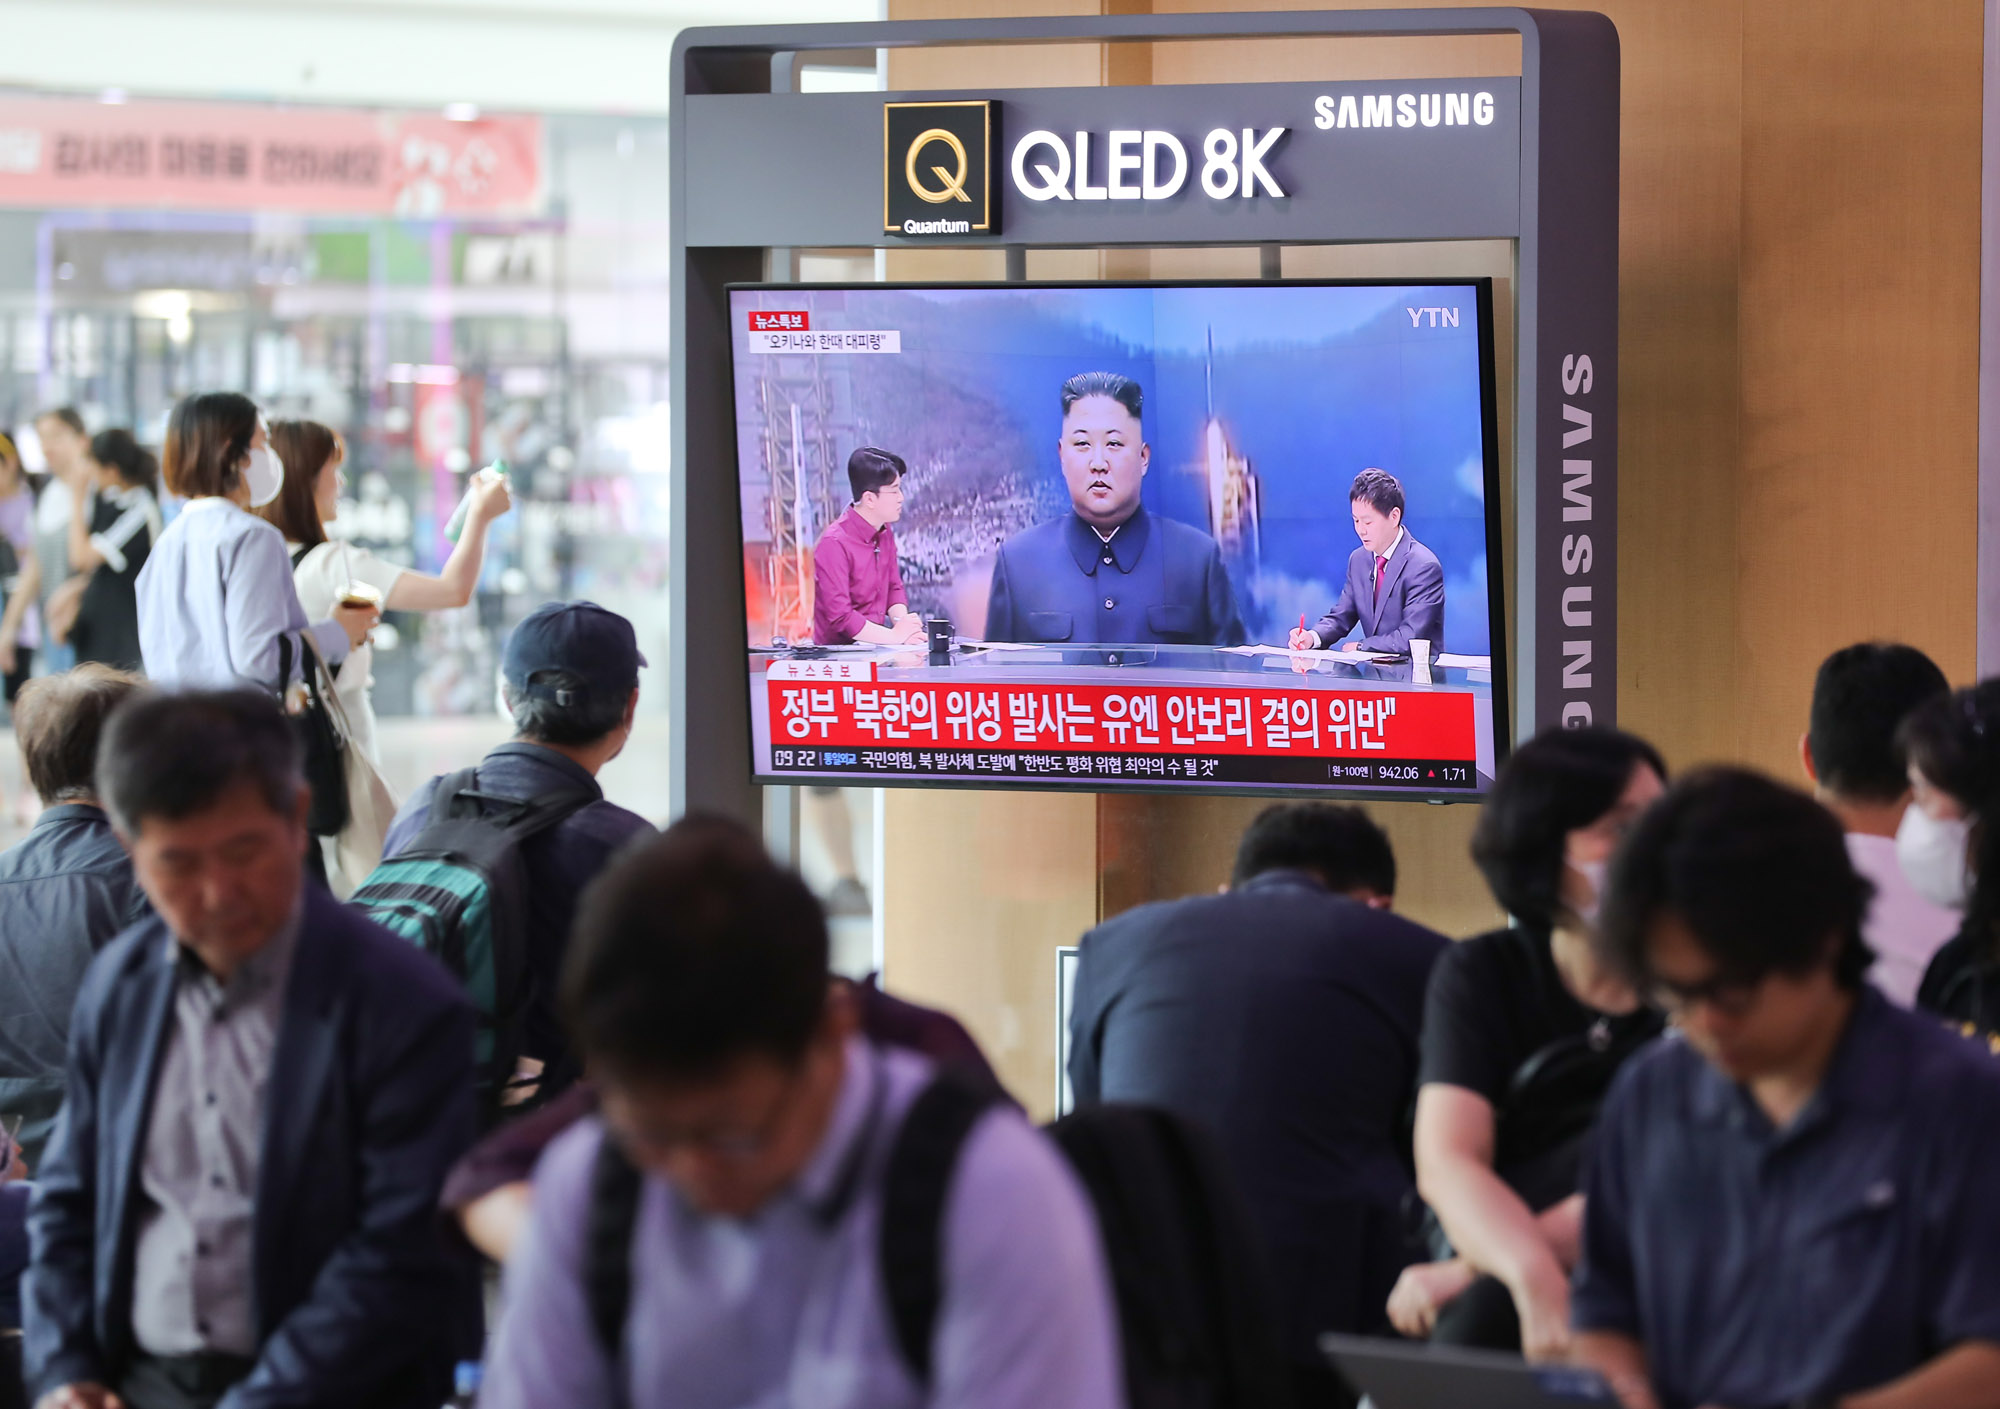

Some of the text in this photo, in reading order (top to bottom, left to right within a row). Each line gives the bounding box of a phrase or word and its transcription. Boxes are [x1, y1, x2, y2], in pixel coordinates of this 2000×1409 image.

[1313, 91, 1495, 130] SAMSUNG
[905, 128, 972, 204] Q
[1011, 127, 1288, 201] QLED 8K
[903, 218, 970, 236] Quantum
[755, 314, 804, 329] 뉴스특보
[1406, 307, 1459, 328] YTN
[764, 334, 887, 351] "오키나와 한때 대피령"
[781, 686, 1396, 750] 정부 "북한의 위성 발사는 유엔 안보리 결의 위반"
[775, 750, 815, 767] 09 22
[823, 752, 857, 766] 통일외교
[861, 751, 1219, 777] 국민의힘, 북 발사체 도발에 "한반도 평화 위협 최악의 수 될 것"
[1332, 765, 1369, 778] 원-100엔
[1378, 766, 1466, 781] 942.06 1.71
